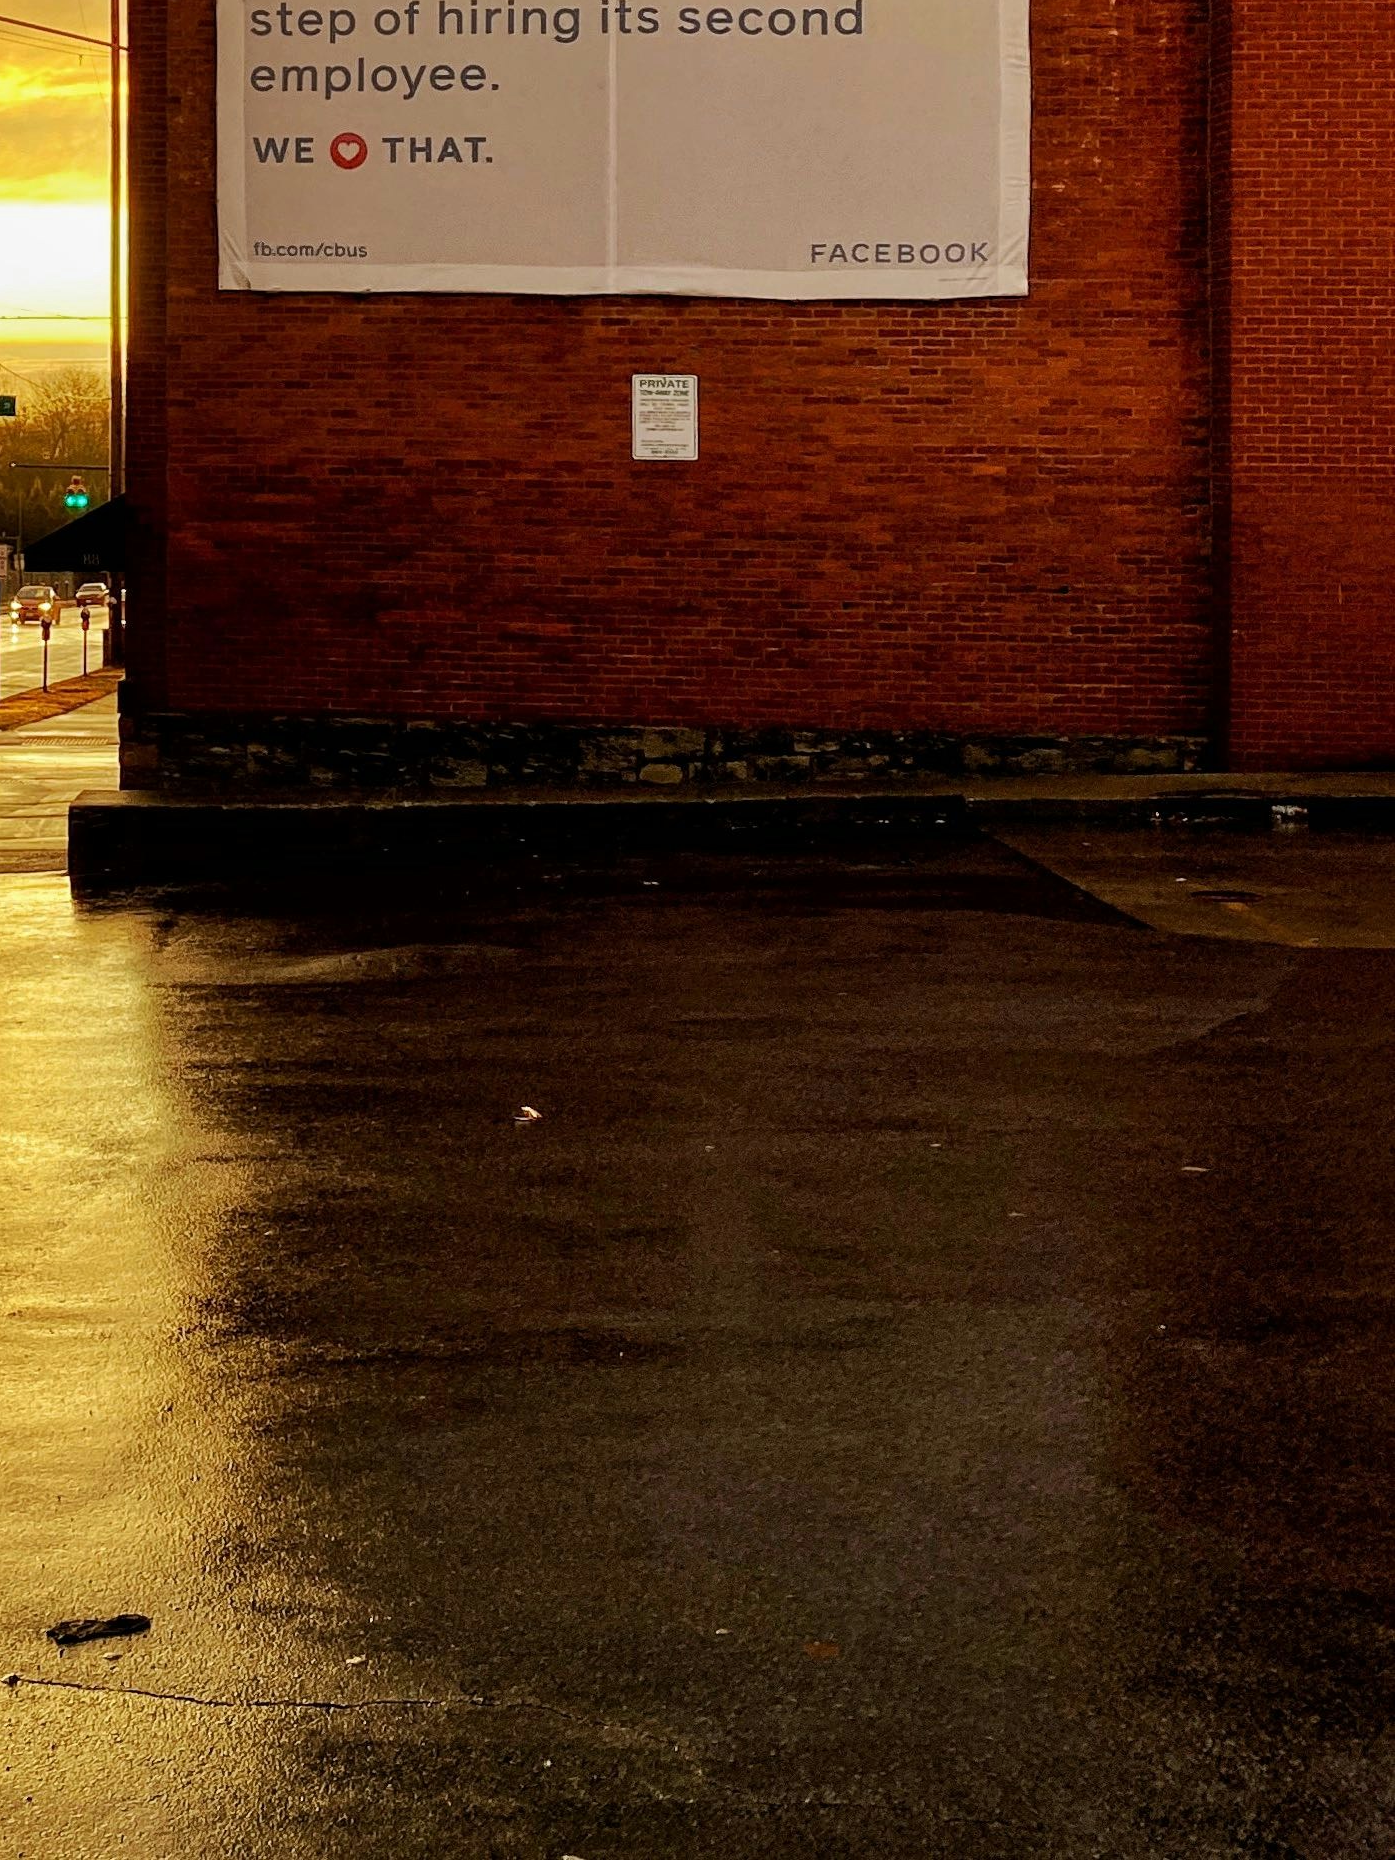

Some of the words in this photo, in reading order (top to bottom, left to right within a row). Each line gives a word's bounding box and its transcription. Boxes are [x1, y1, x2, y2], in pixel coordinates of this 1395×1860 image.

[249, 2, 356, 44] step
[373, 1, 421, 36] of
[438, 0, 581, 44] hiring
[600, 0, 660, 35] its
[677, 0, 864, 36] second
[249, 58, 500, 100] employee.
[252, 137, 315, 163] WE
[381, 137, 493, 163] THAT.
[253, 240, 368, 259] fb.com/cbus
[810, 242, 989, 264] FACEBOOK
[639, 379, 689, 389] PRIVATE
